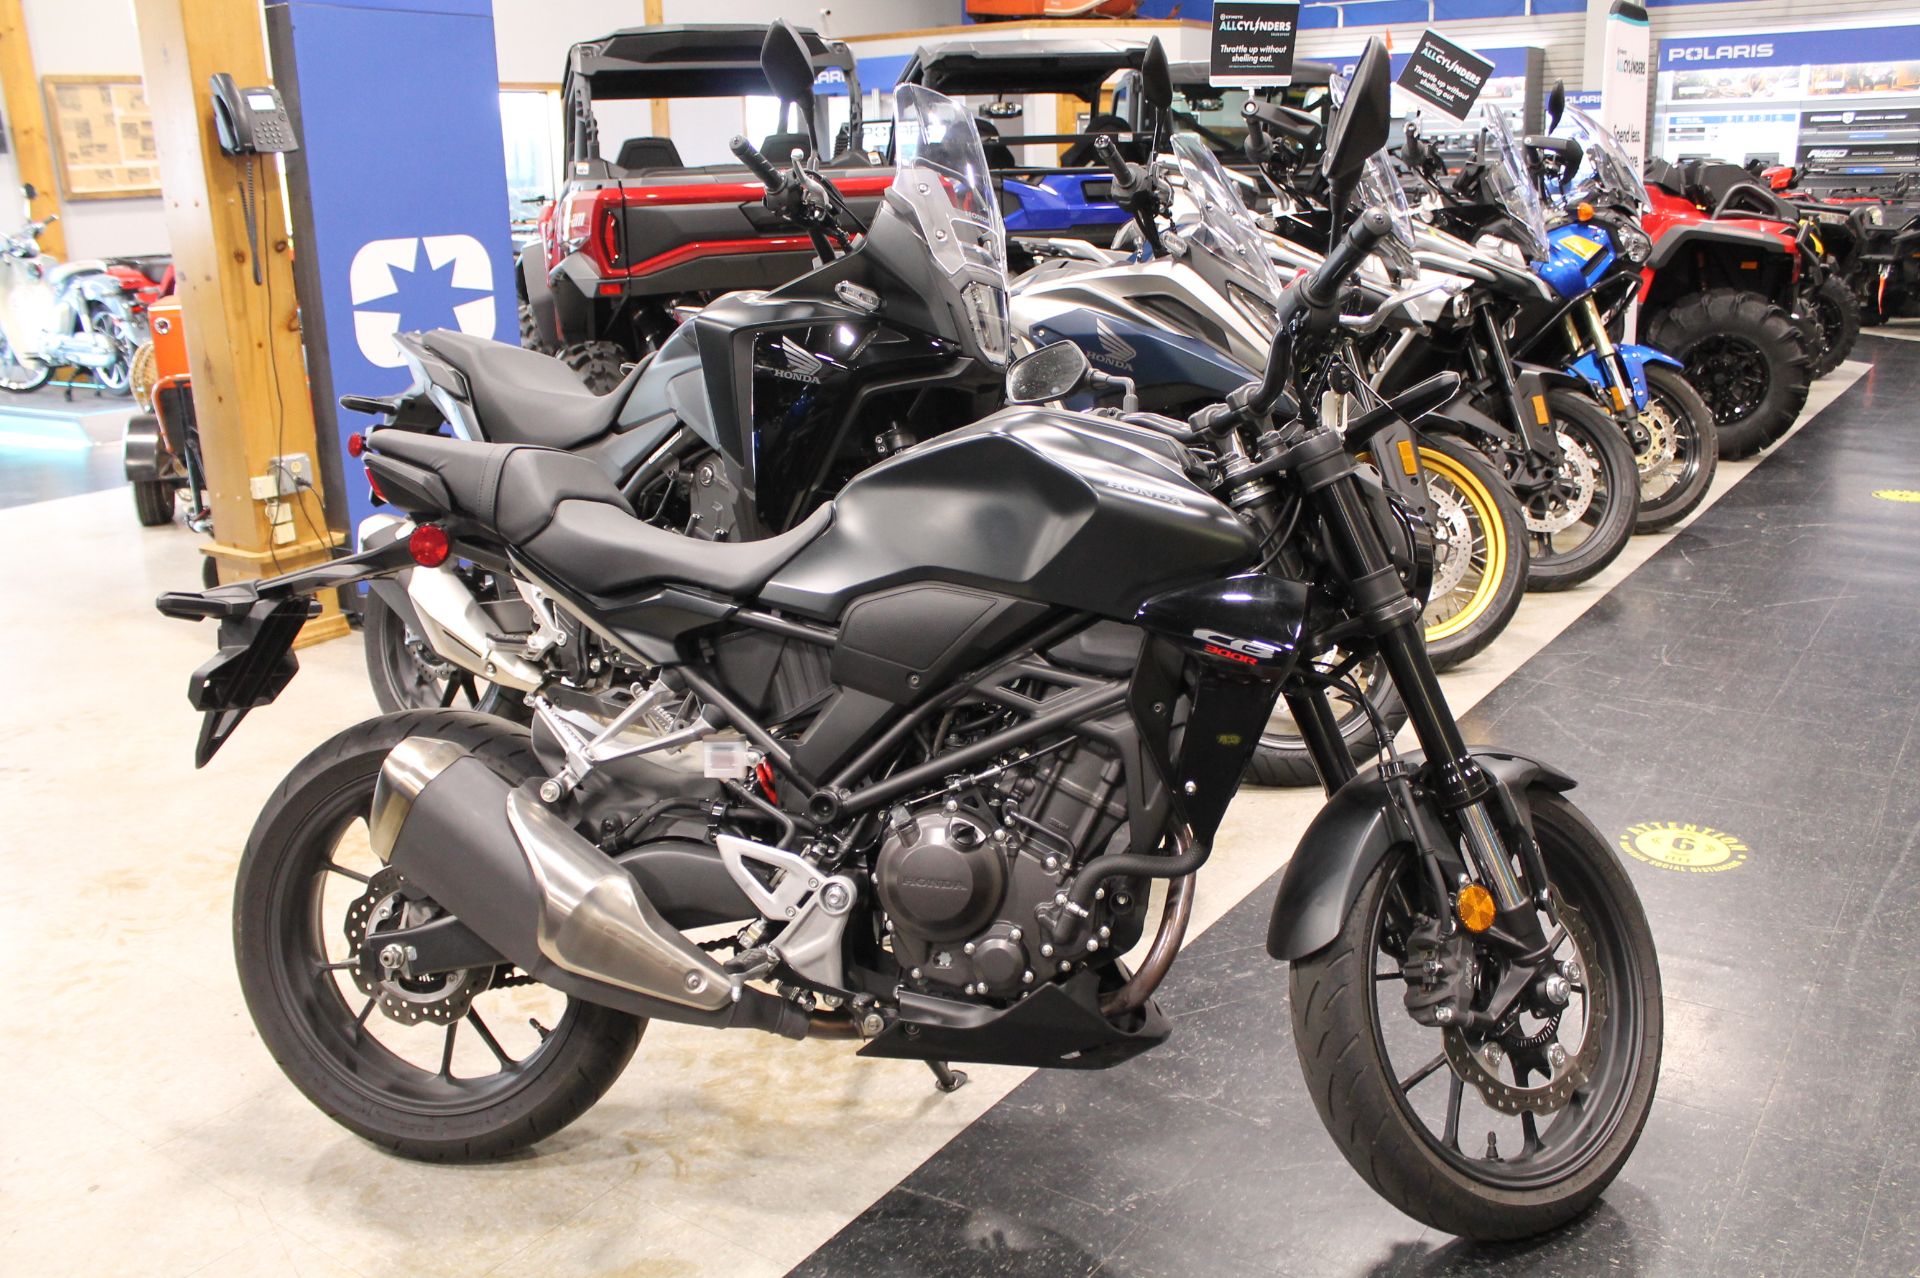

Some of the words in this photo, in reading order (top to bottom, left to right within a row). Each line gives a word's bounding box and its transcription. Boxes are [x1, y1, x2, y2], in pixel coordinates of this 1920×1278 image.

[1220, 44, 1247, 53] Throttle
[1249, 46, 1258, 55] up
[1260, 45, 1287, 53] without
[1668, 43, 1774, 62] POLARIS
[1231, 54, 1258, 64] shelling
[1414, 65, 1438, 83] Throttle
[1437, 79, 1446, 88] up
[1447, 84, 1470, 100] without
[1420, 79, 1443, 97] shelling
[1565, 95, 1601, 105] OLARI
[1086, 350, 1134, 372] HONDA
[774, 368, 821, 385] HONDA
[1104, 480, 1186, 508] HONDA
[1203, 643, 1259, 666] 300R
[1626, 821, 1748, 851] ATTENTION
[1672, 837, 1694, 851] 6
[1649, 860, 1686, 872] SOCIAL
[901, 877, 968, 891] HONDA
